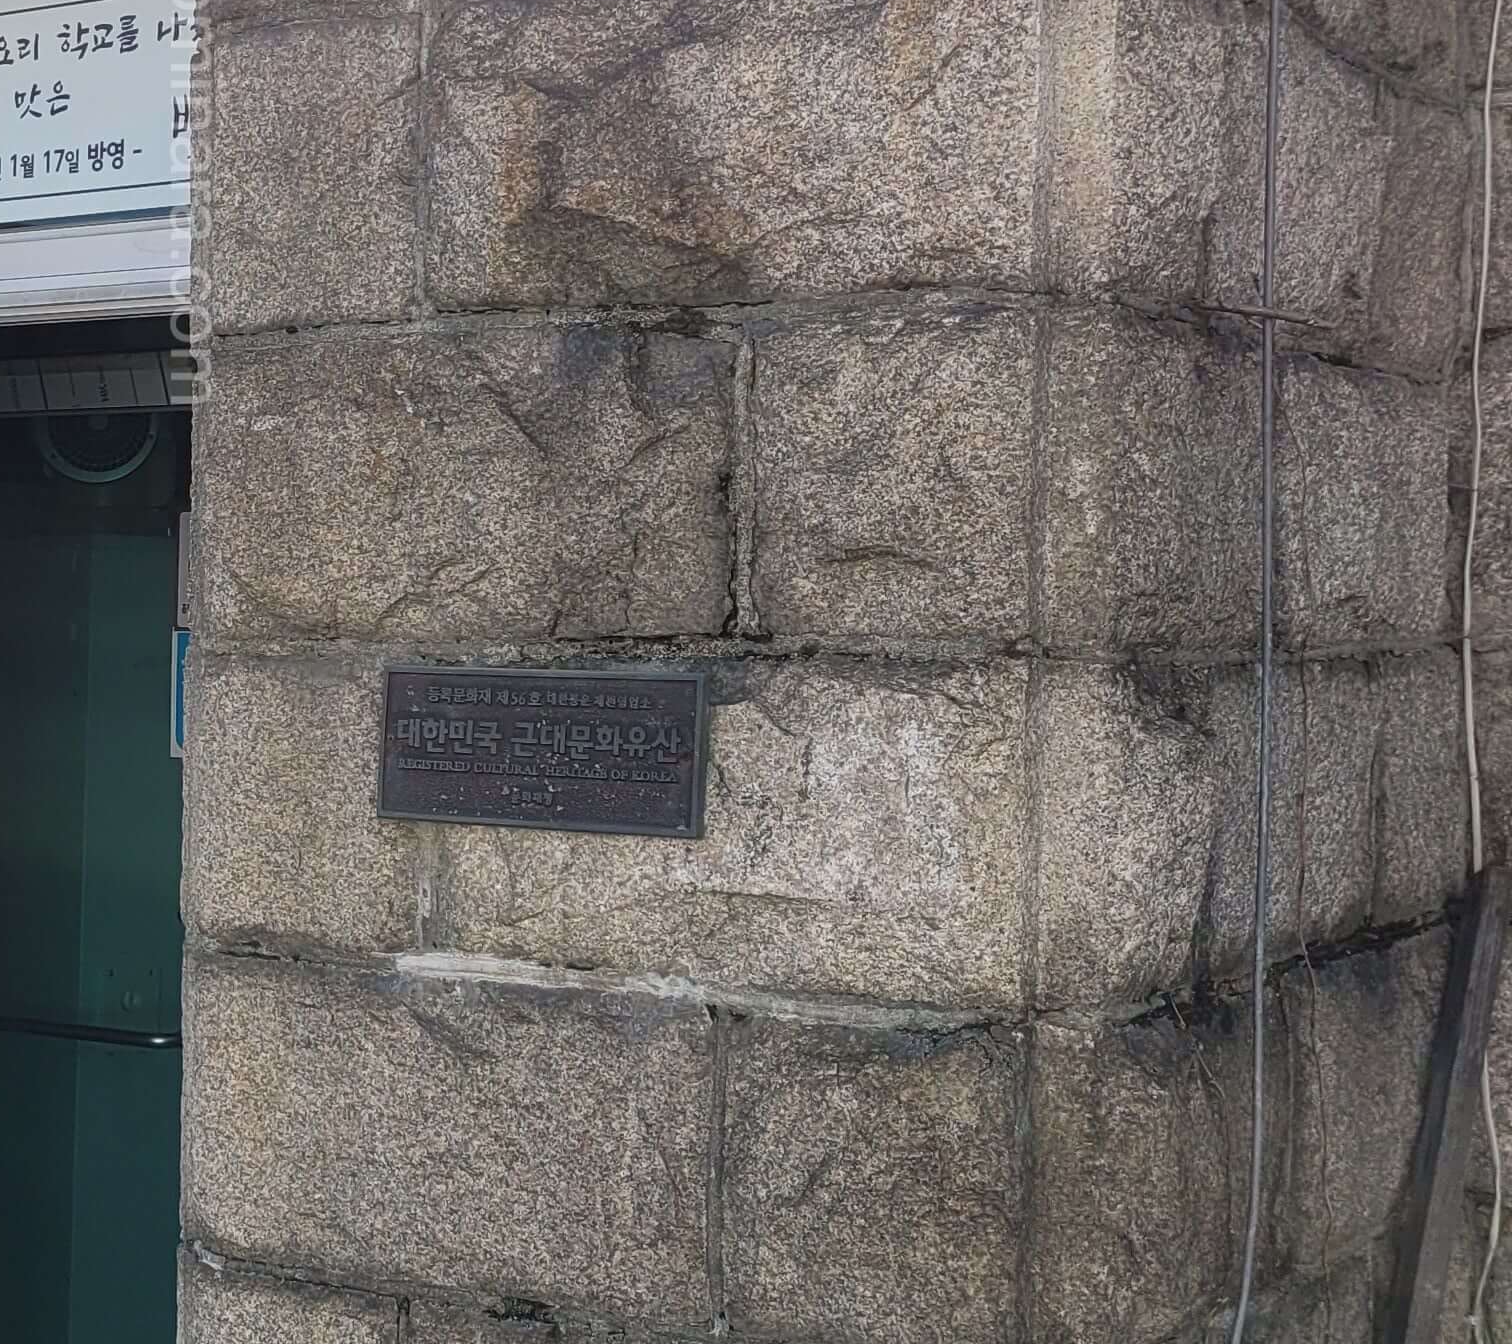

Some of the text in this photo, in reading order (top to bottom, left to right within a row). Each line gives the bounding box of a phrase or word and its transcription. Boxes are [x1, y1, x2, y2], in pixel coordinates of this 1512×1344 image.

[57, 15, 139, 60] 학교를
[15, 81, 71, 119] 맛은
[11, 153, 35, 179] 1월
[44, 149, 80, 173] 17일
[87, 139, 126, 172] 방영
[428, 686, 492, 704] 등록문화재
[396, 718, 681, 764] 대한민국 근대문화유산
[398, 758, 470, 772] REGISTERED
[474, 761, 539, 776] CULTURAL
[611, 769, 630, 781] OF
[632, 769, 680, 784] KOREA
